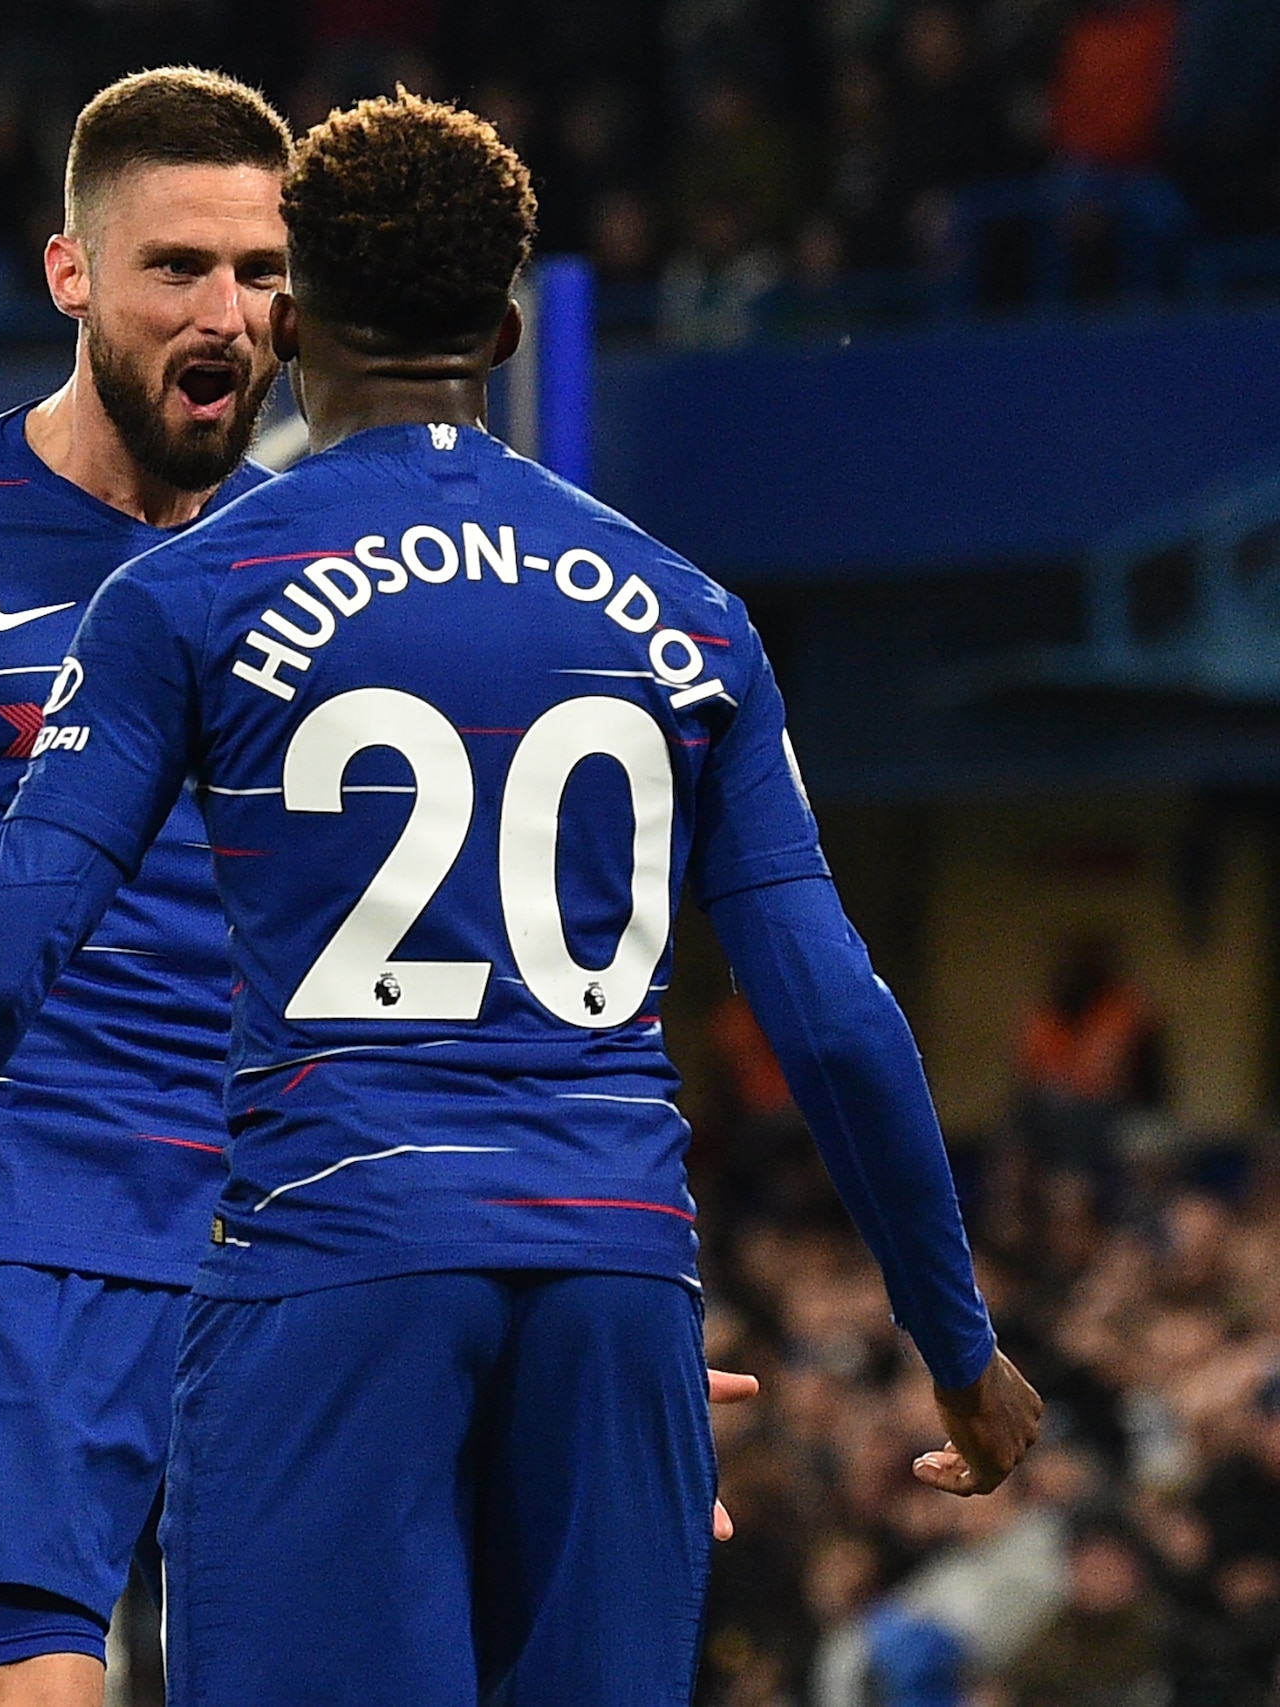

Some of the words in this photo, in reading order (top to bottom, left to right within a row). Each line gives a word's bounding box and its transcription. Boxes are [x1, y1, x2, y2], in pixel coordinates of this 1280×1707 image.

[231, 521, 725, 711] HUDSON-ODOI
[31, 726, 90, 757] DAI
[282, 687, 674, 1029] 20
